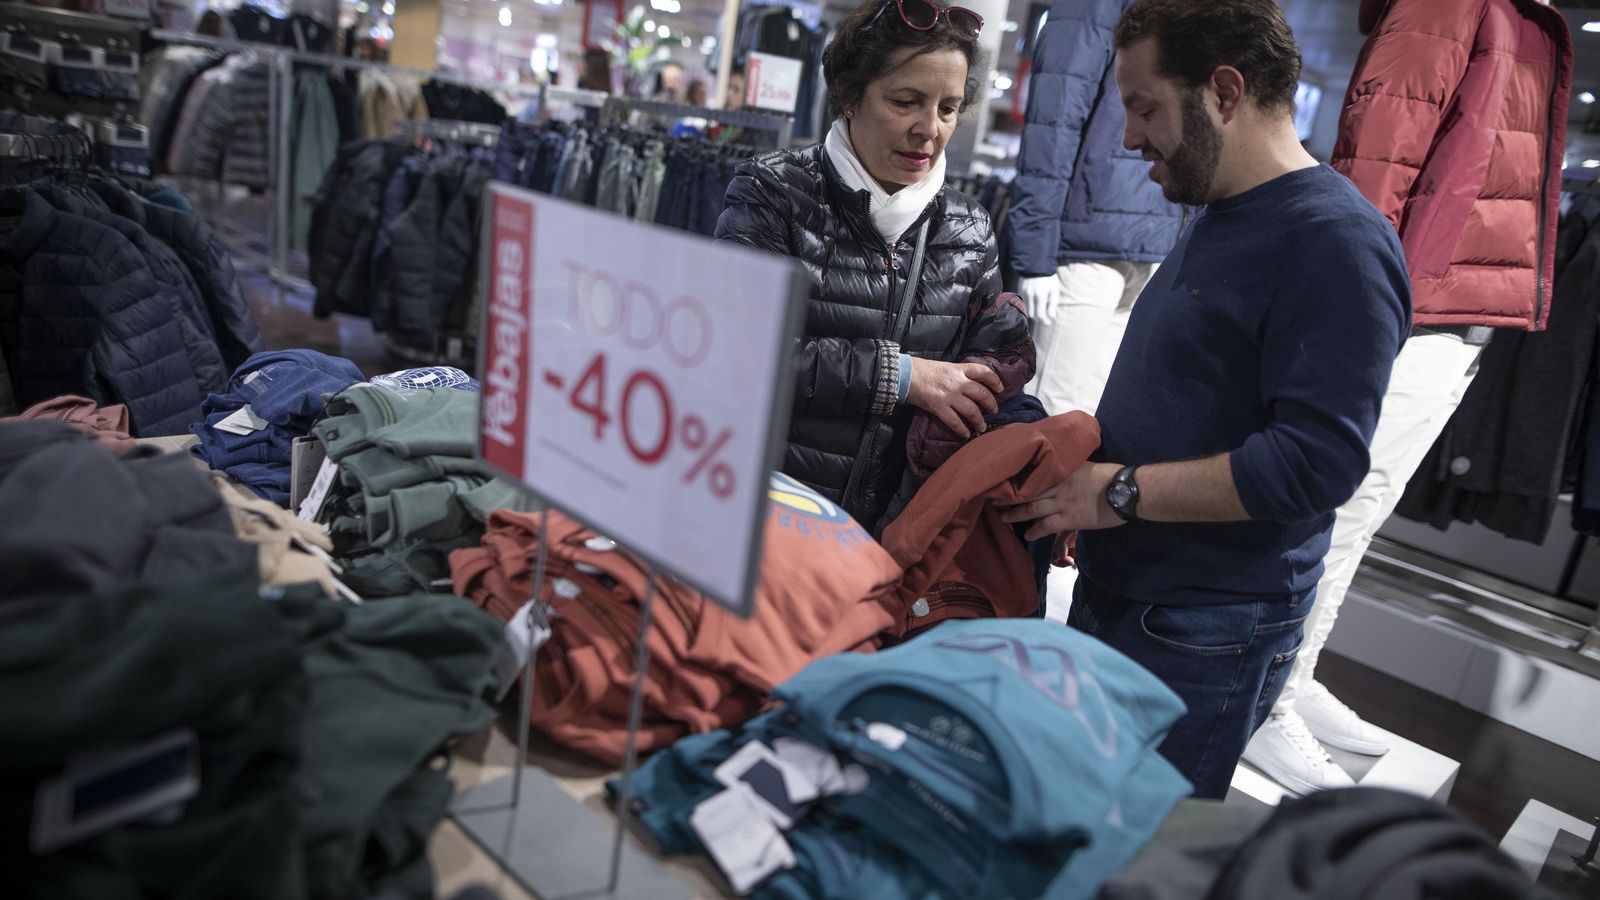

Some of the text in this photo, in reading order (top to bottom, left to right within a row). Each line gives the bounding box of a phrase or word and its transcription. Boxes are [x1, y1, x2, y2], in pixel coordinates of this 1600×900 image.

[482, 240, 527, 448] rebajas
[561, 258, 713, 369] TODO
[542, 352, 737, 499] -40%
